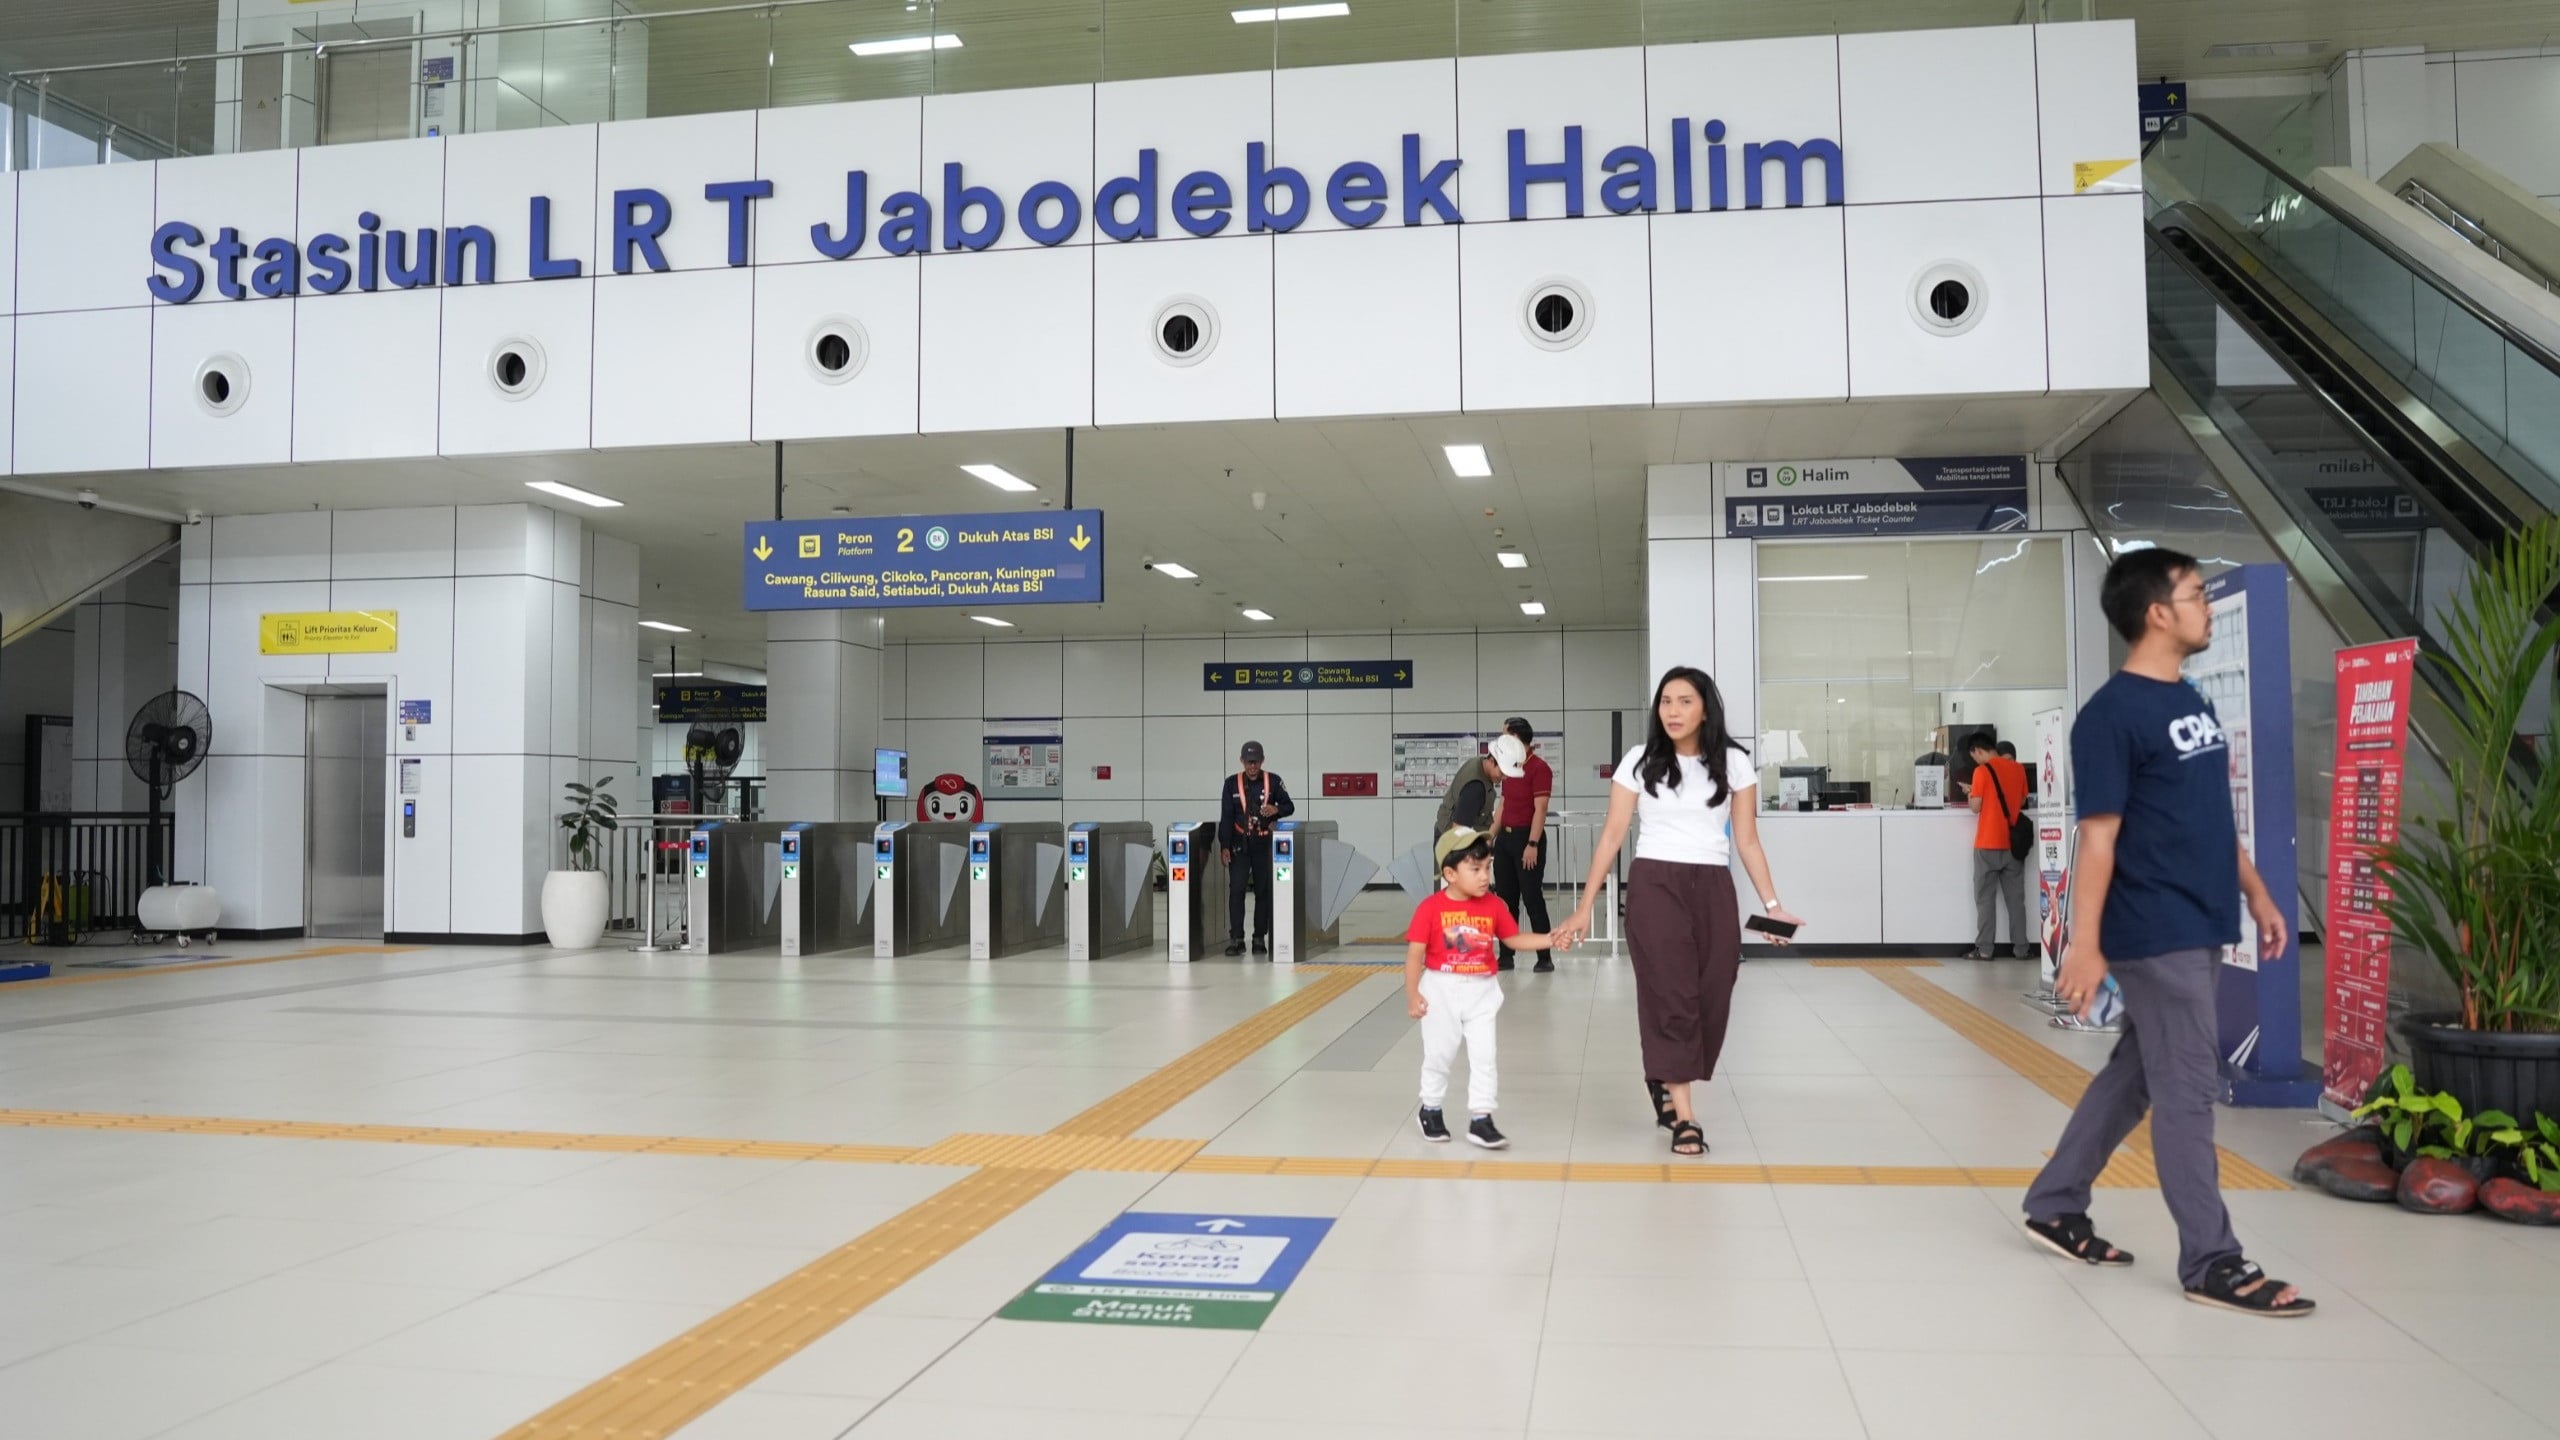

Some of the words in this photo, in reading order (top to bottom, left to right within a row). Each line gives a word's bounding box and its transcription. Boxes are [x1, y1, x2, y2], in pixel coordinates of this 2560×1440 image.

[147, 211, 495, 304] Stasiun
[811, 133, 1463, 259] Jabodebek
[1507, 117, 1845, 220] Halim
[1803, 467, 1849, 482] Halim
[1936, 473, 1968, 481] Mobilitas
[1791, 504, 1824, 515] Loket
[1827, 503, 1849, 514] LRT
[1852, 501, 1918, 514] Jabodebek
[1792, 517, 1807, 526] LRT
[1809, 516, 1854, 526] Jabodebek
[1856, 515, 1880, 524] Ticket
[1882, 514, 1915, 523] Counter
[838, 532, 873, 545] Peron
[896, 528, 914, 553] 2
[958, 531, 999, 544] Dukuh
[1002, 530, 1030, 543] Atas
[1033, 528, 1054, 541] BSI
[838, 546, 873, 557] Platform
[765, 573, 817, 589] Cawang,
[820, 570, 878, 588] Ciliwung,
[881, 570, 928, 586] Cikoko,
[931, 568, 992, 584] Pancoran,
[996, 566, 1055, 582] Kuningan
[803, 585, 847, 598] Rasuna
[849, 584, 880, 599] Said,
[882, 583, 945, 598] Setiabudi,
[948, 581, 989, 595] Dukuh
[991, 580, 1020, 594] Atas
[1023, 579, 1044, 592] BSI
[304, 625, 318, 633] Lift
[320, 625, 351, 633] Prioritas
[353, 624, 378, 632] Keluar
[1255, 669, 1278, 677] Peron
[1283, 669, 1293, 683] 2
[1317, 667, 1350, 676] Cawang
[1317, 675, 1344, 684] Dukuh
[1346, 675, 1364, 683] Atas
[1366, 674, 1379, 683] BSI
[1136, 1252, 1240, 1262] Kereta
[1124, 1260, 1239, 1269] sepeda
[1086, 1300, 1195, 1313] Masuk
[1071, 1307, 1193, 1321] Stasiun
